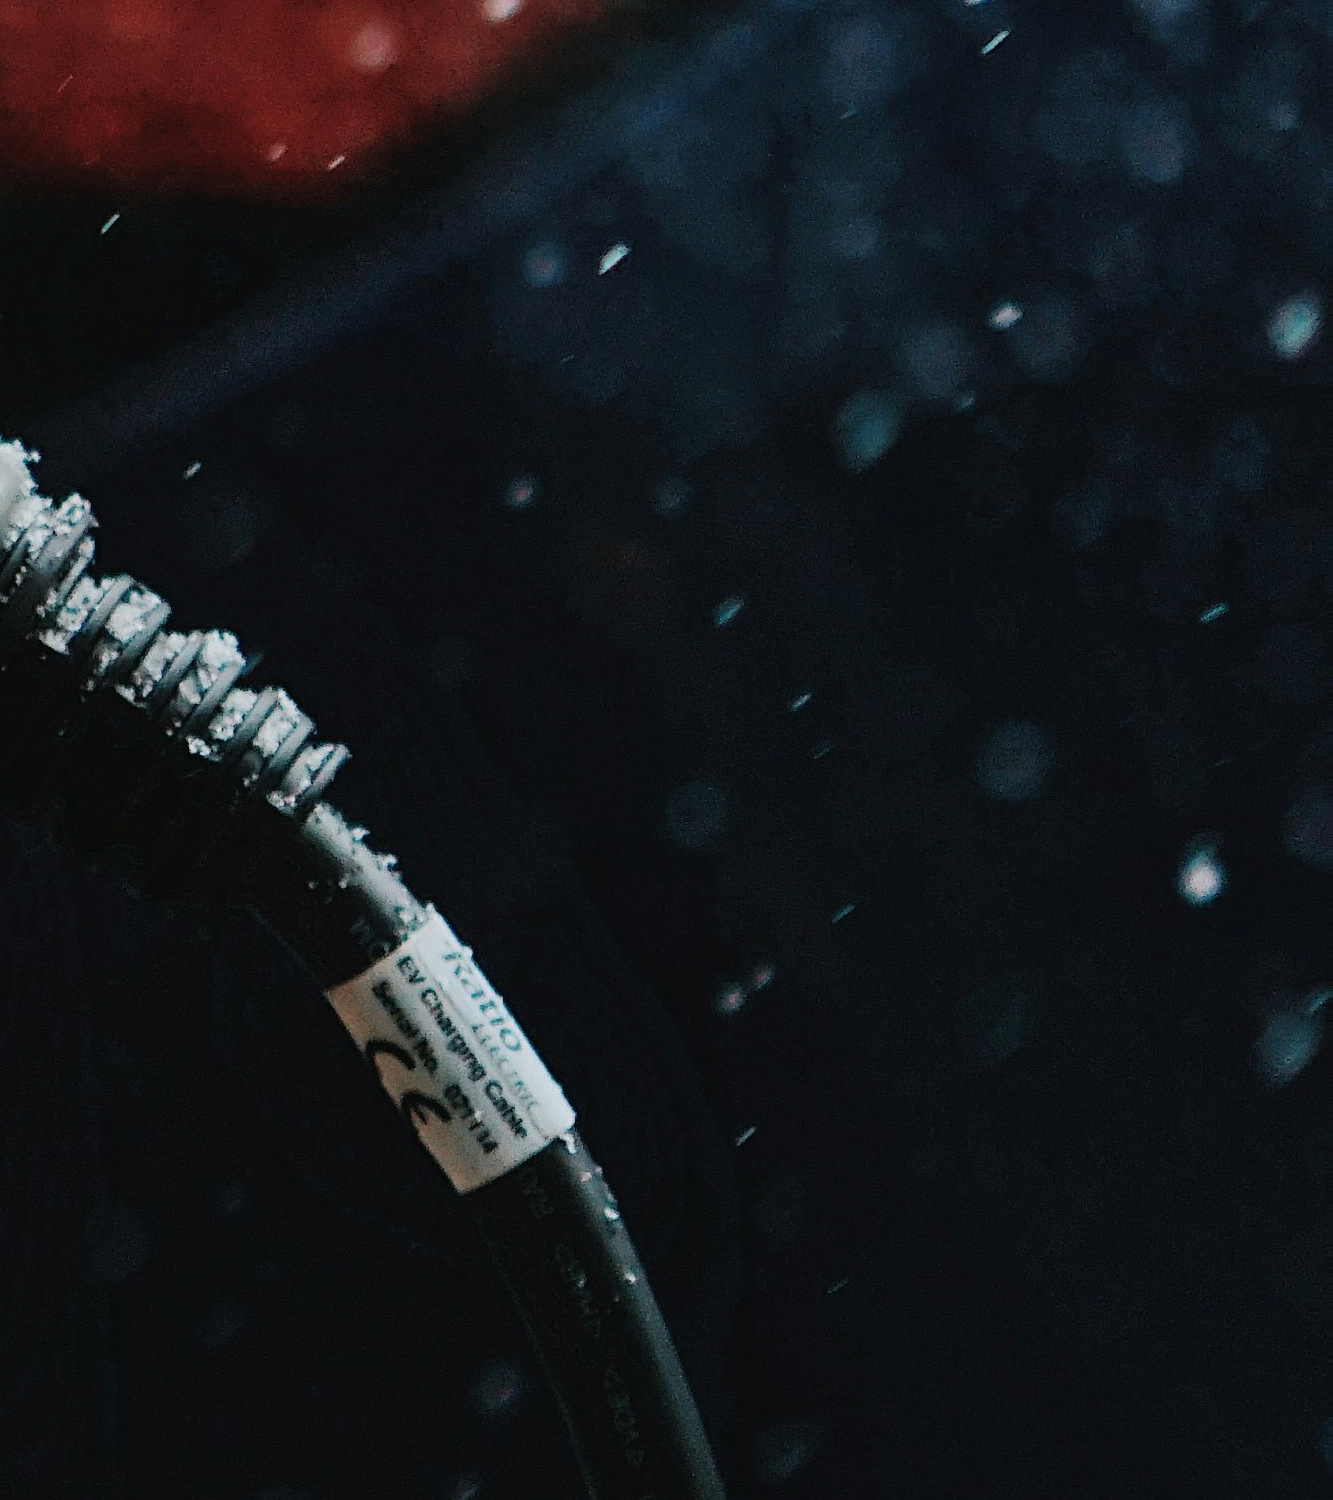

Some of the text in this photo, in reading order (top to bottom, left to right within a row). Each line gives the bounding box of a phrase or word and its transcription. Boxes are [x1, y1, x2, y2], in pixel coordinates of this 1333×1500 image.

[396, 955, 529, 1139] EV Charging Cable
[444, 949, 522, 1053] Ratio
